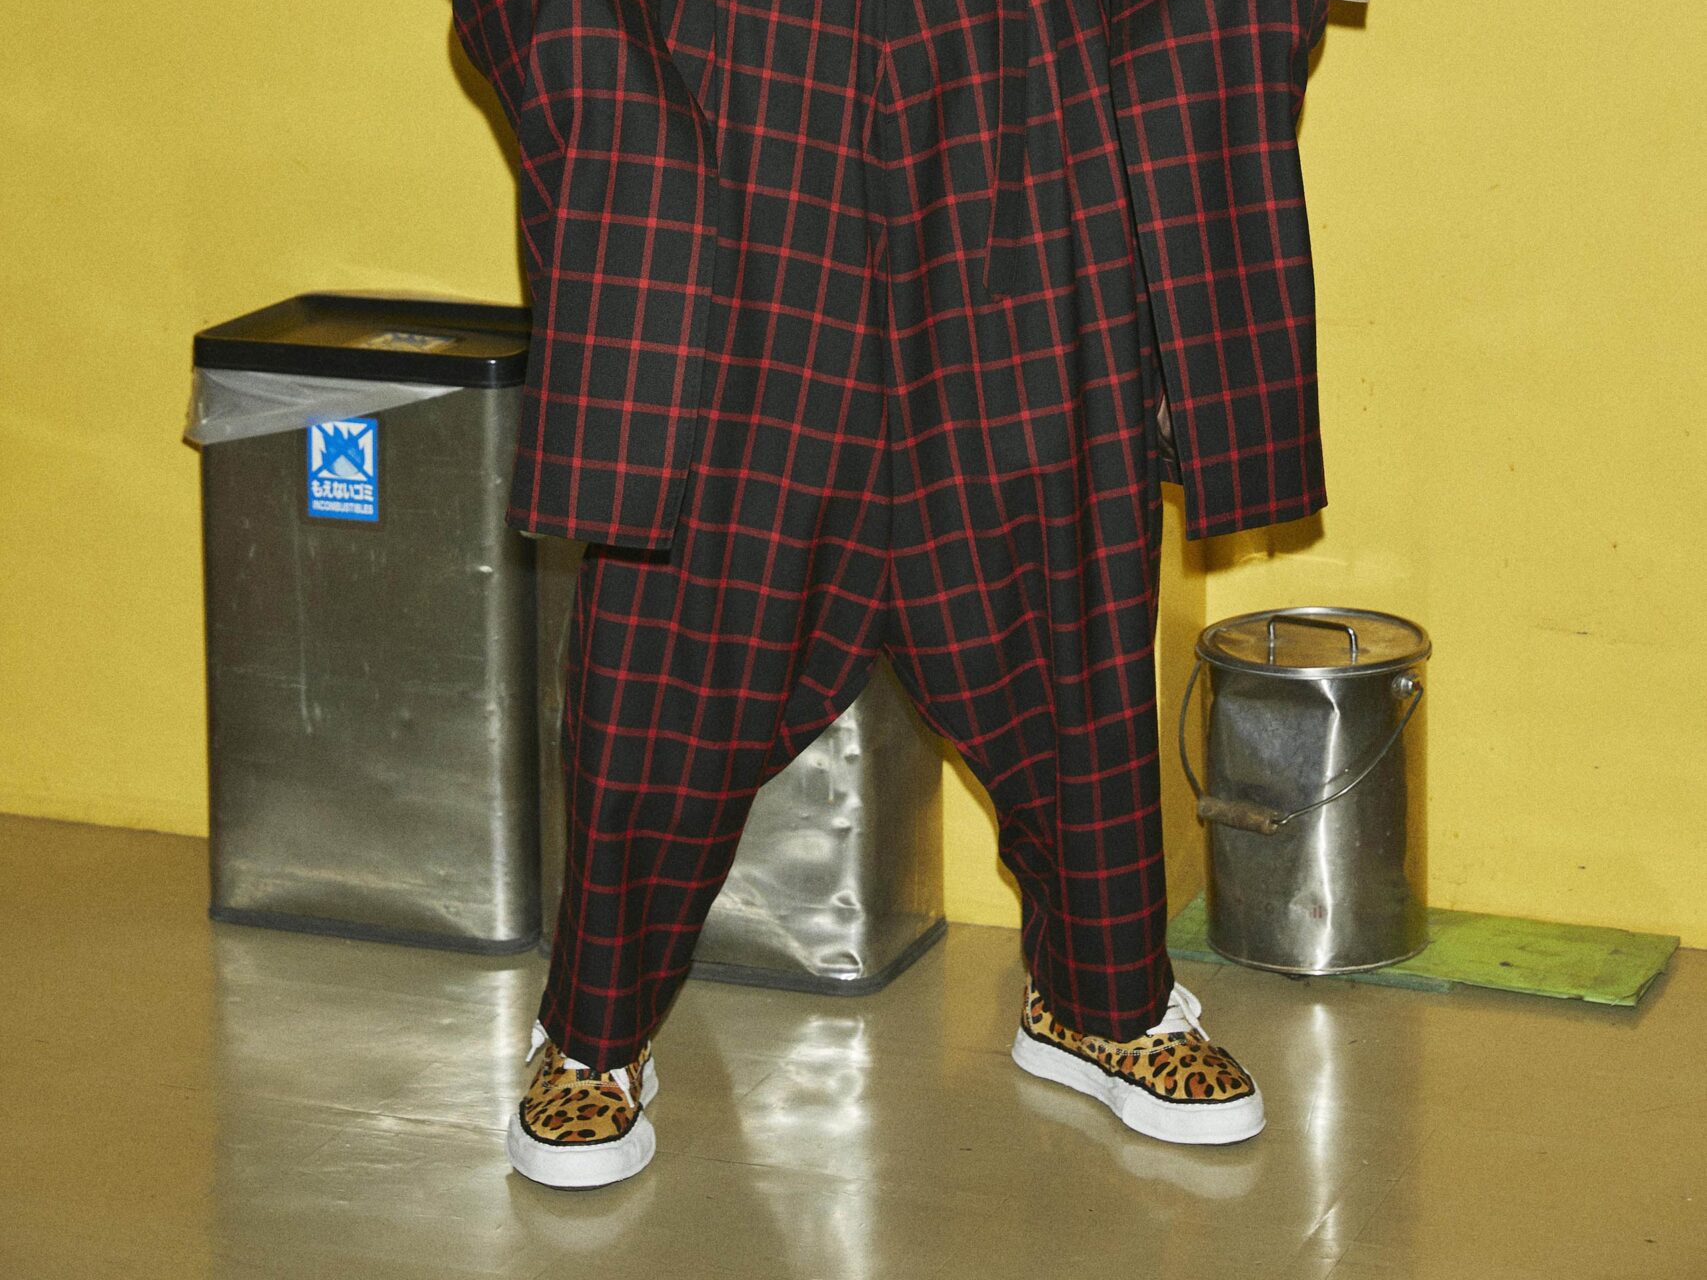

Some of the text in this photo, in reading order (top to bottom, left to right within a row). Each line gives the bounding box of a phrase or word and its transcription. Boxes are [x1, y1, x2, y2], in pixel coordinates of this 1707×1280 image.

[311, 480, 374, 502] もえないゴミ
